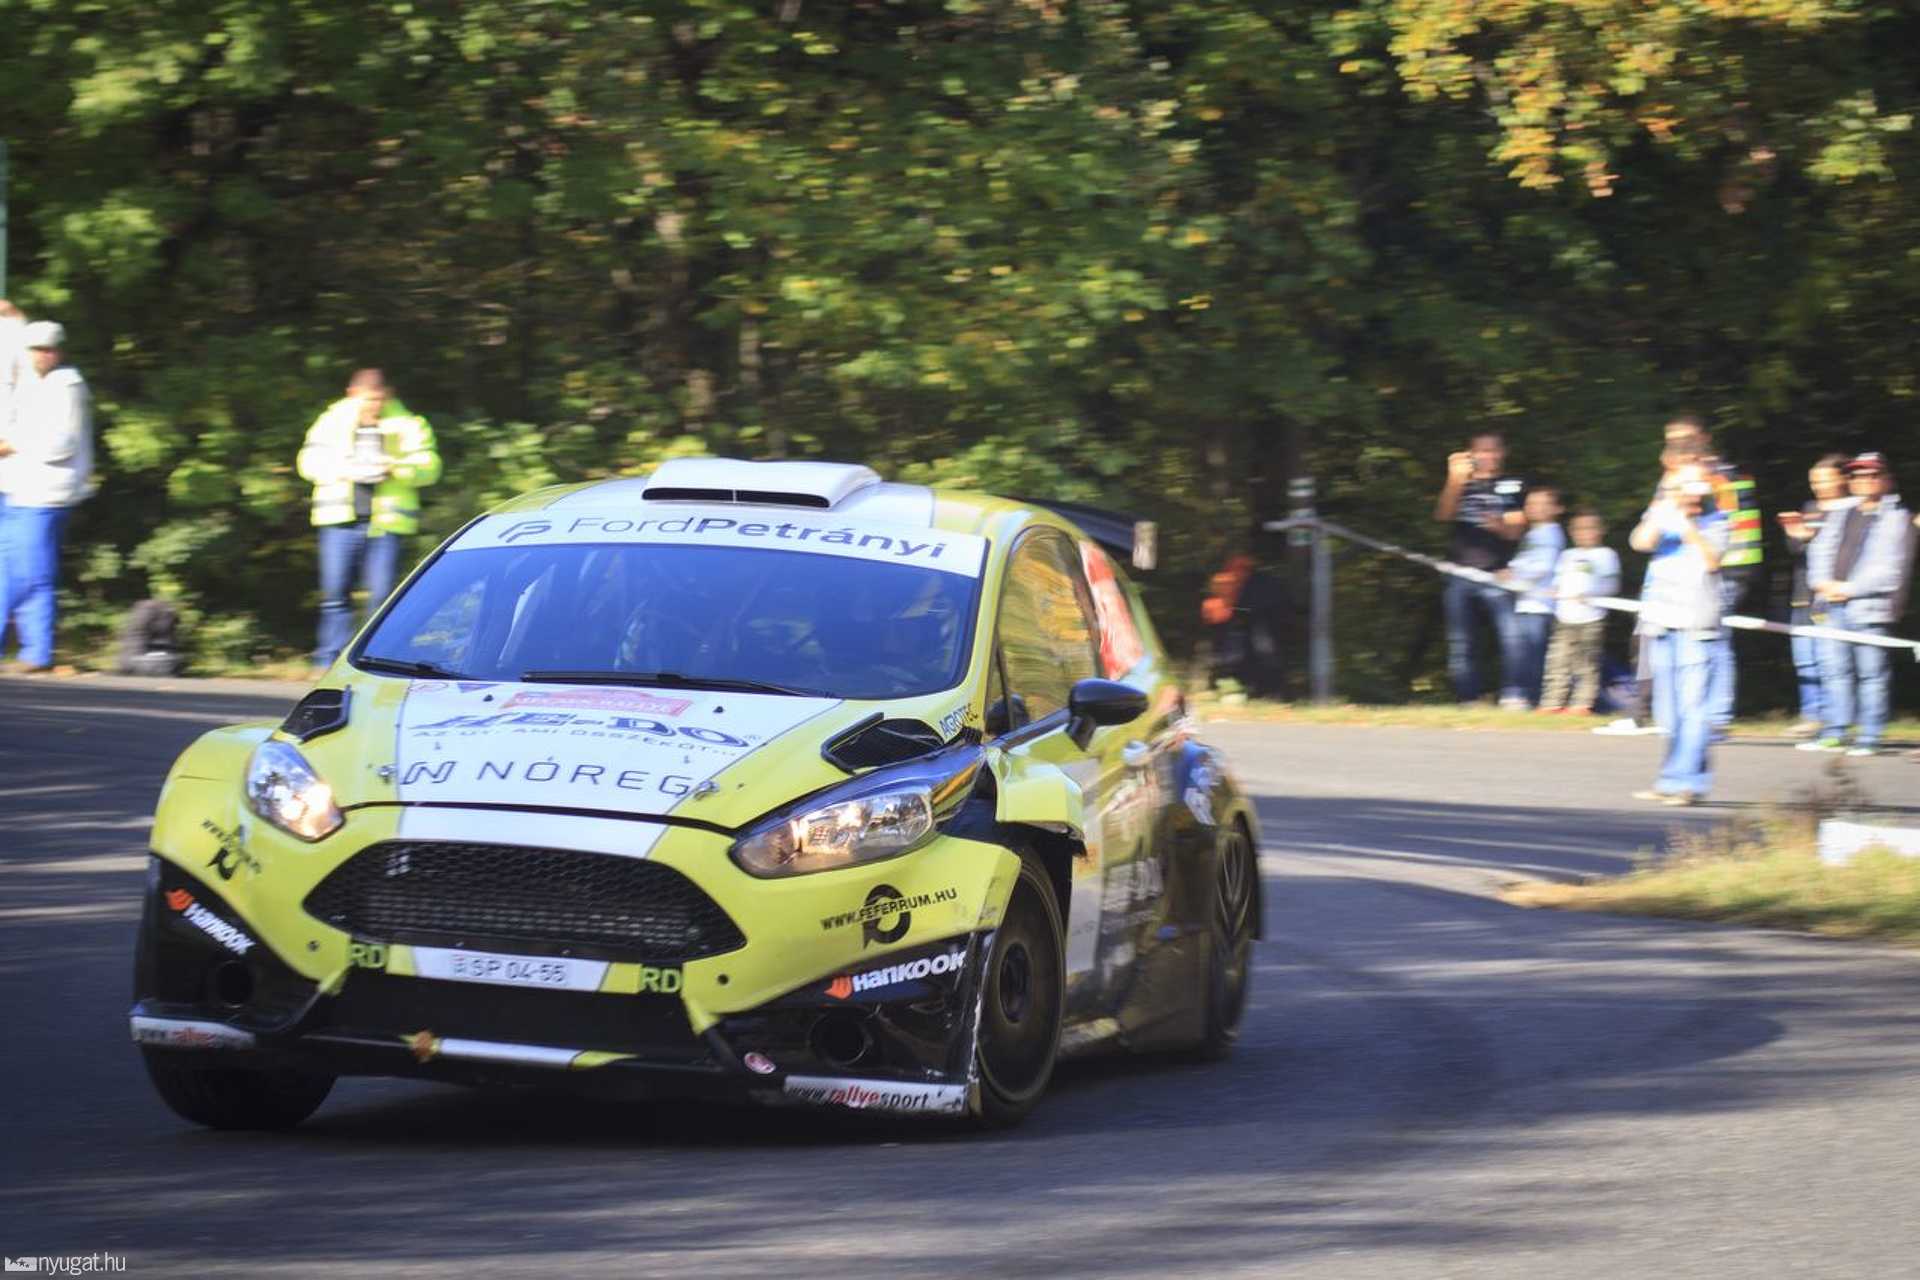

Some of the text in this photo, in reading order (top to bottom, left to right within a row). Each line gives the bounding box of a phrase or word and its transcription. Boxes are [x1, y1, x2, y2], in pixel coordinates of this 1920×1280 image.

[567, 516, 948, 559] FordPetrányi
[476, 756, 693, 798] NÓREG
[472, 959, 501, 977] SP
[641, 967, 682, 993] RD
